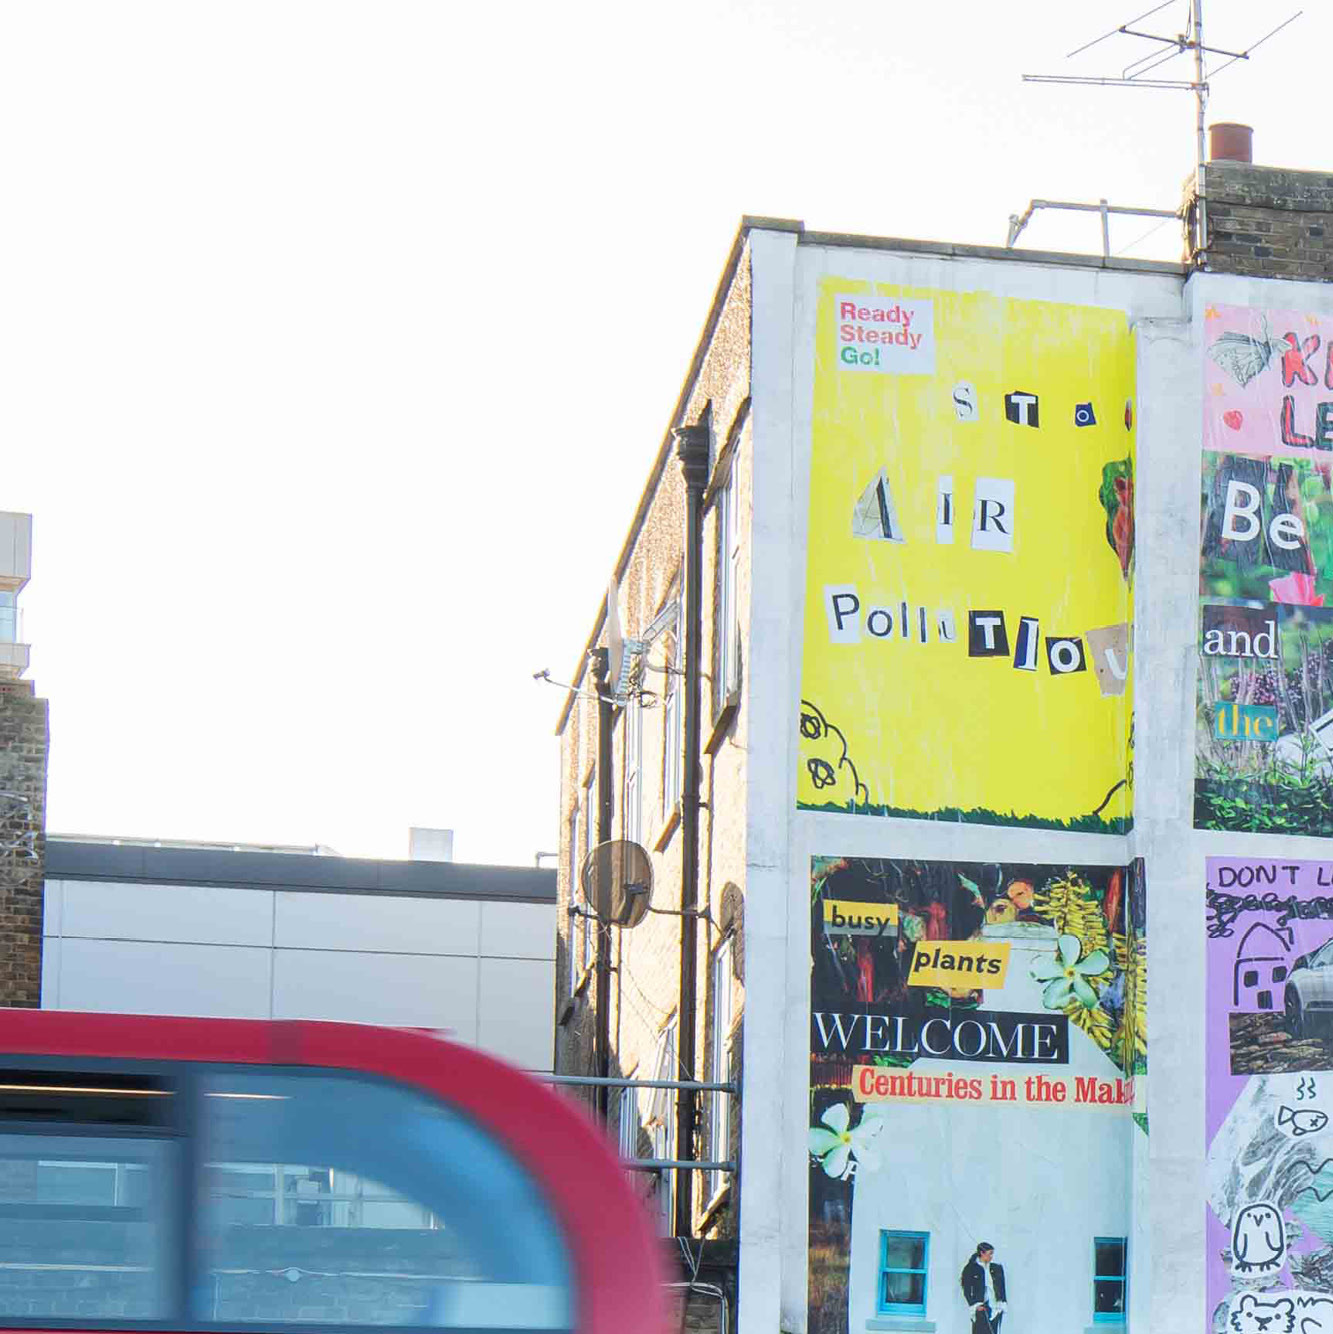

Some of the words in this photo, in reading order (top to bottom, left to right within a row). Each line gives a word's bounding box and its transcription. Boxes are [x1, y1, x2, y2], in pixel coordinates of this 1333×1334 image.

[840, 301, 914, 327] Ready
[840, 325, 922, 350] Steady
[840, 346, 881, 367] Go!
[855, 474, 1012, 540] AIR
[1222, 480, 1304, 549] Be
[1203, 621, 1279, 659] and
[1217, 705, 1273, 738] the
[831, 905, 890, 936] busy
[914, 947, 1002, 976] plants
[812, 1010, 1060, 1061] WELCOME
[858, 1067, 983, 1101] Centuries
[991, 1073, 1014, 1101] in
[1024, 1074, 1066, 1102] the
